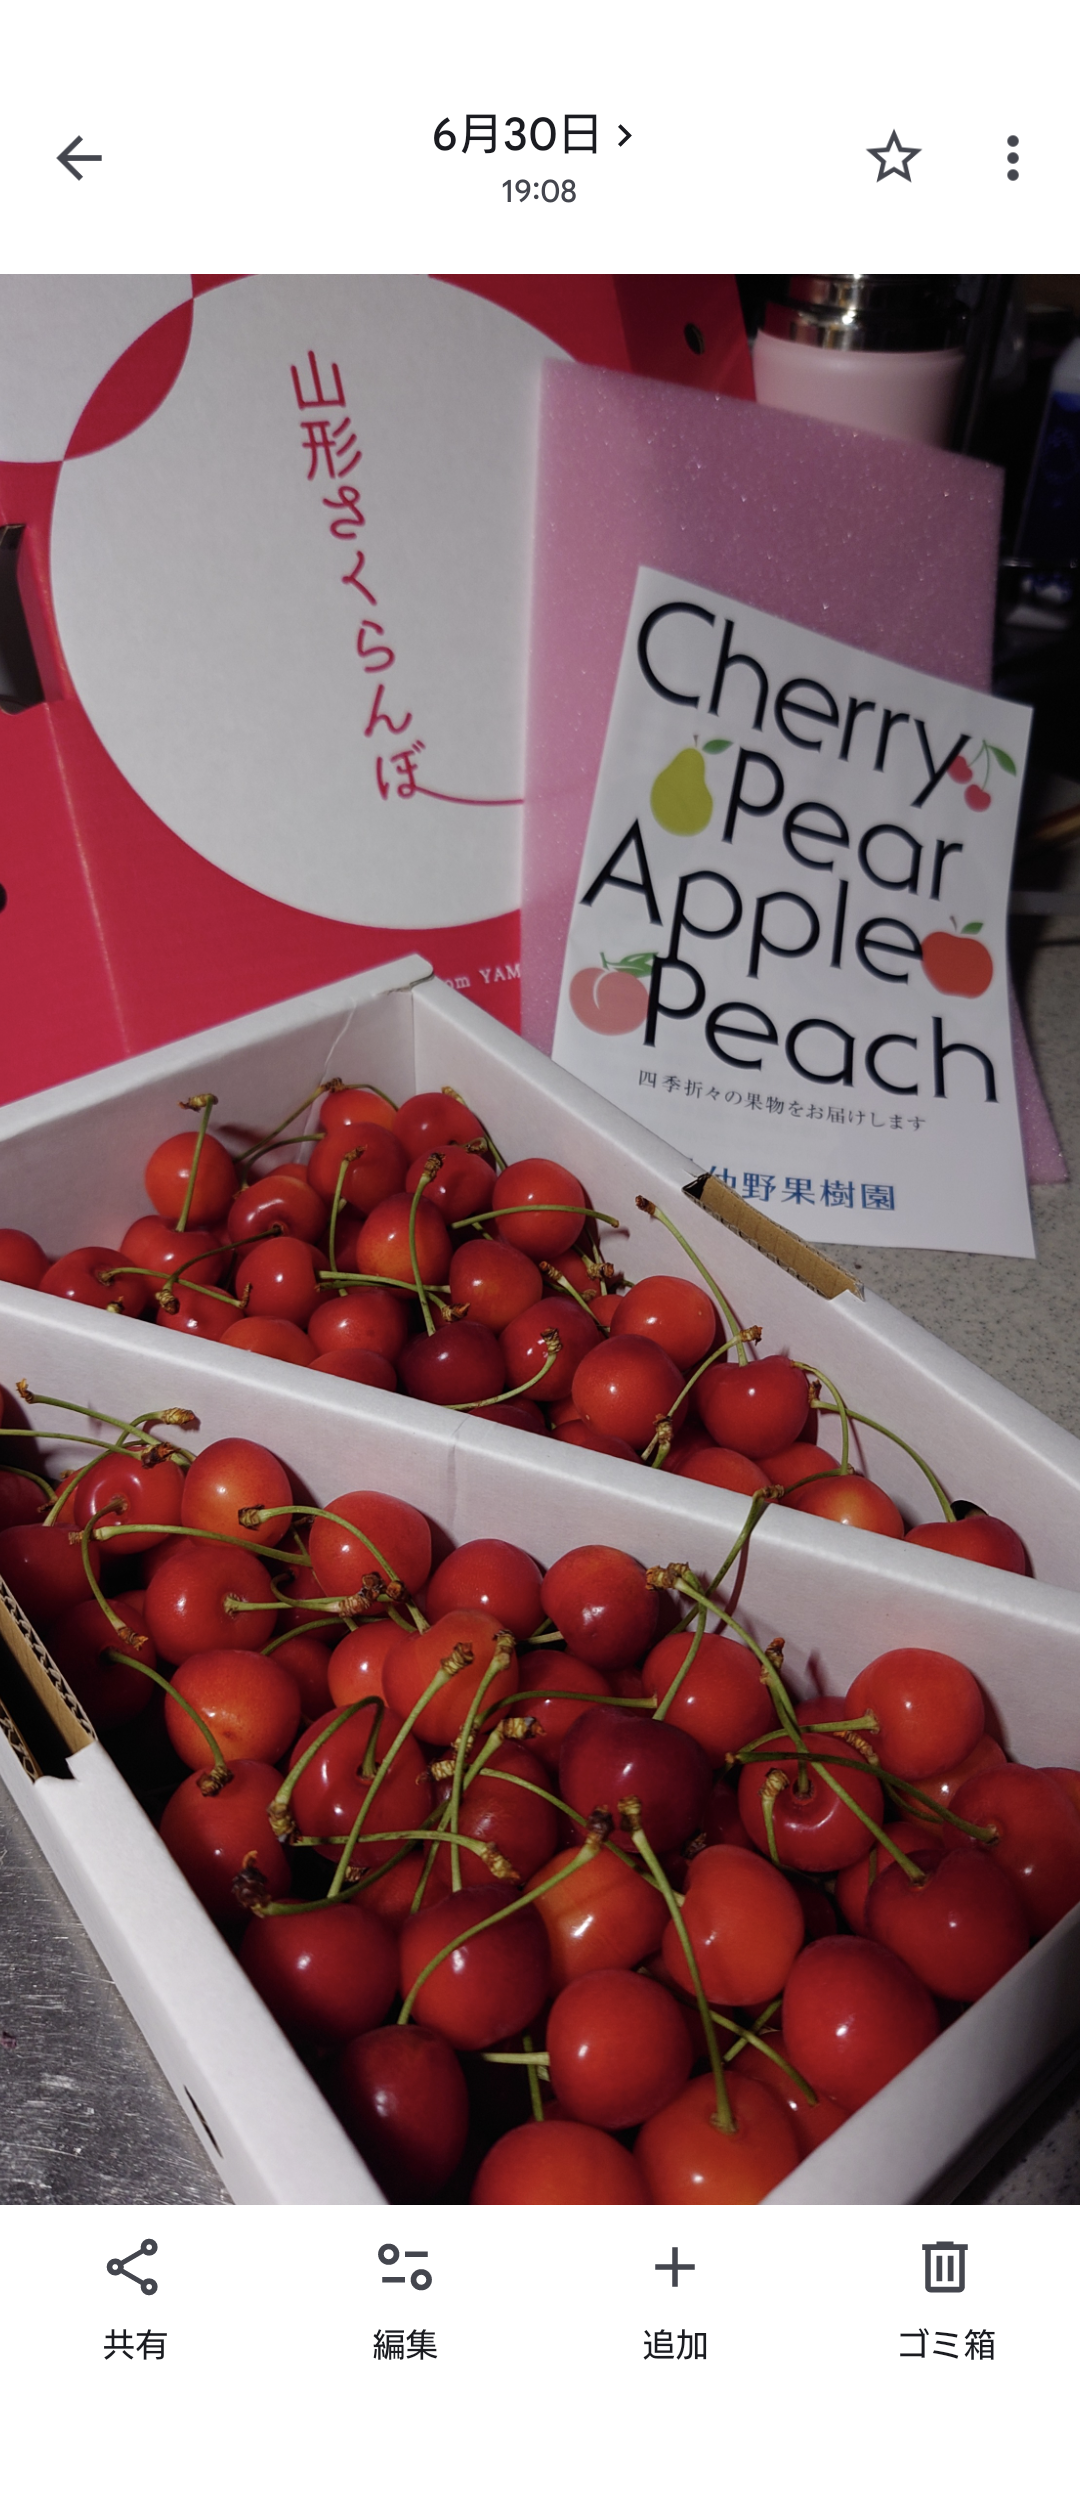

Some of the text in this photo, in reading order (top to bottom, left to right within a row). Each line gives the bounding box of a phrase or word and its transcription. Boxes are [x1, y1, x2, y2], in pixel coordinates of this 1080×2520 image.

[433, 114, 597, 154] 6月30日
[502, 178, 577, 203] 19:08
[290, 350, 426, 801] 山形さくらんぼ
[637, 601, 971, 808] Cherry
[721, 747, 962, 899] Pear
[580, 818, 923, 984] Apple
[643, 953, 999, 1103] Peach
[638, 1069, 926, 1132] 四季折々の果物をお届けします
[103, 2328, 168, 2361] 共有
[373, 2328, 438, 2361] 編集
[643, 2328, 707, 2361] 追加
[899, 2327, 996, 2361] ゴミ箱
